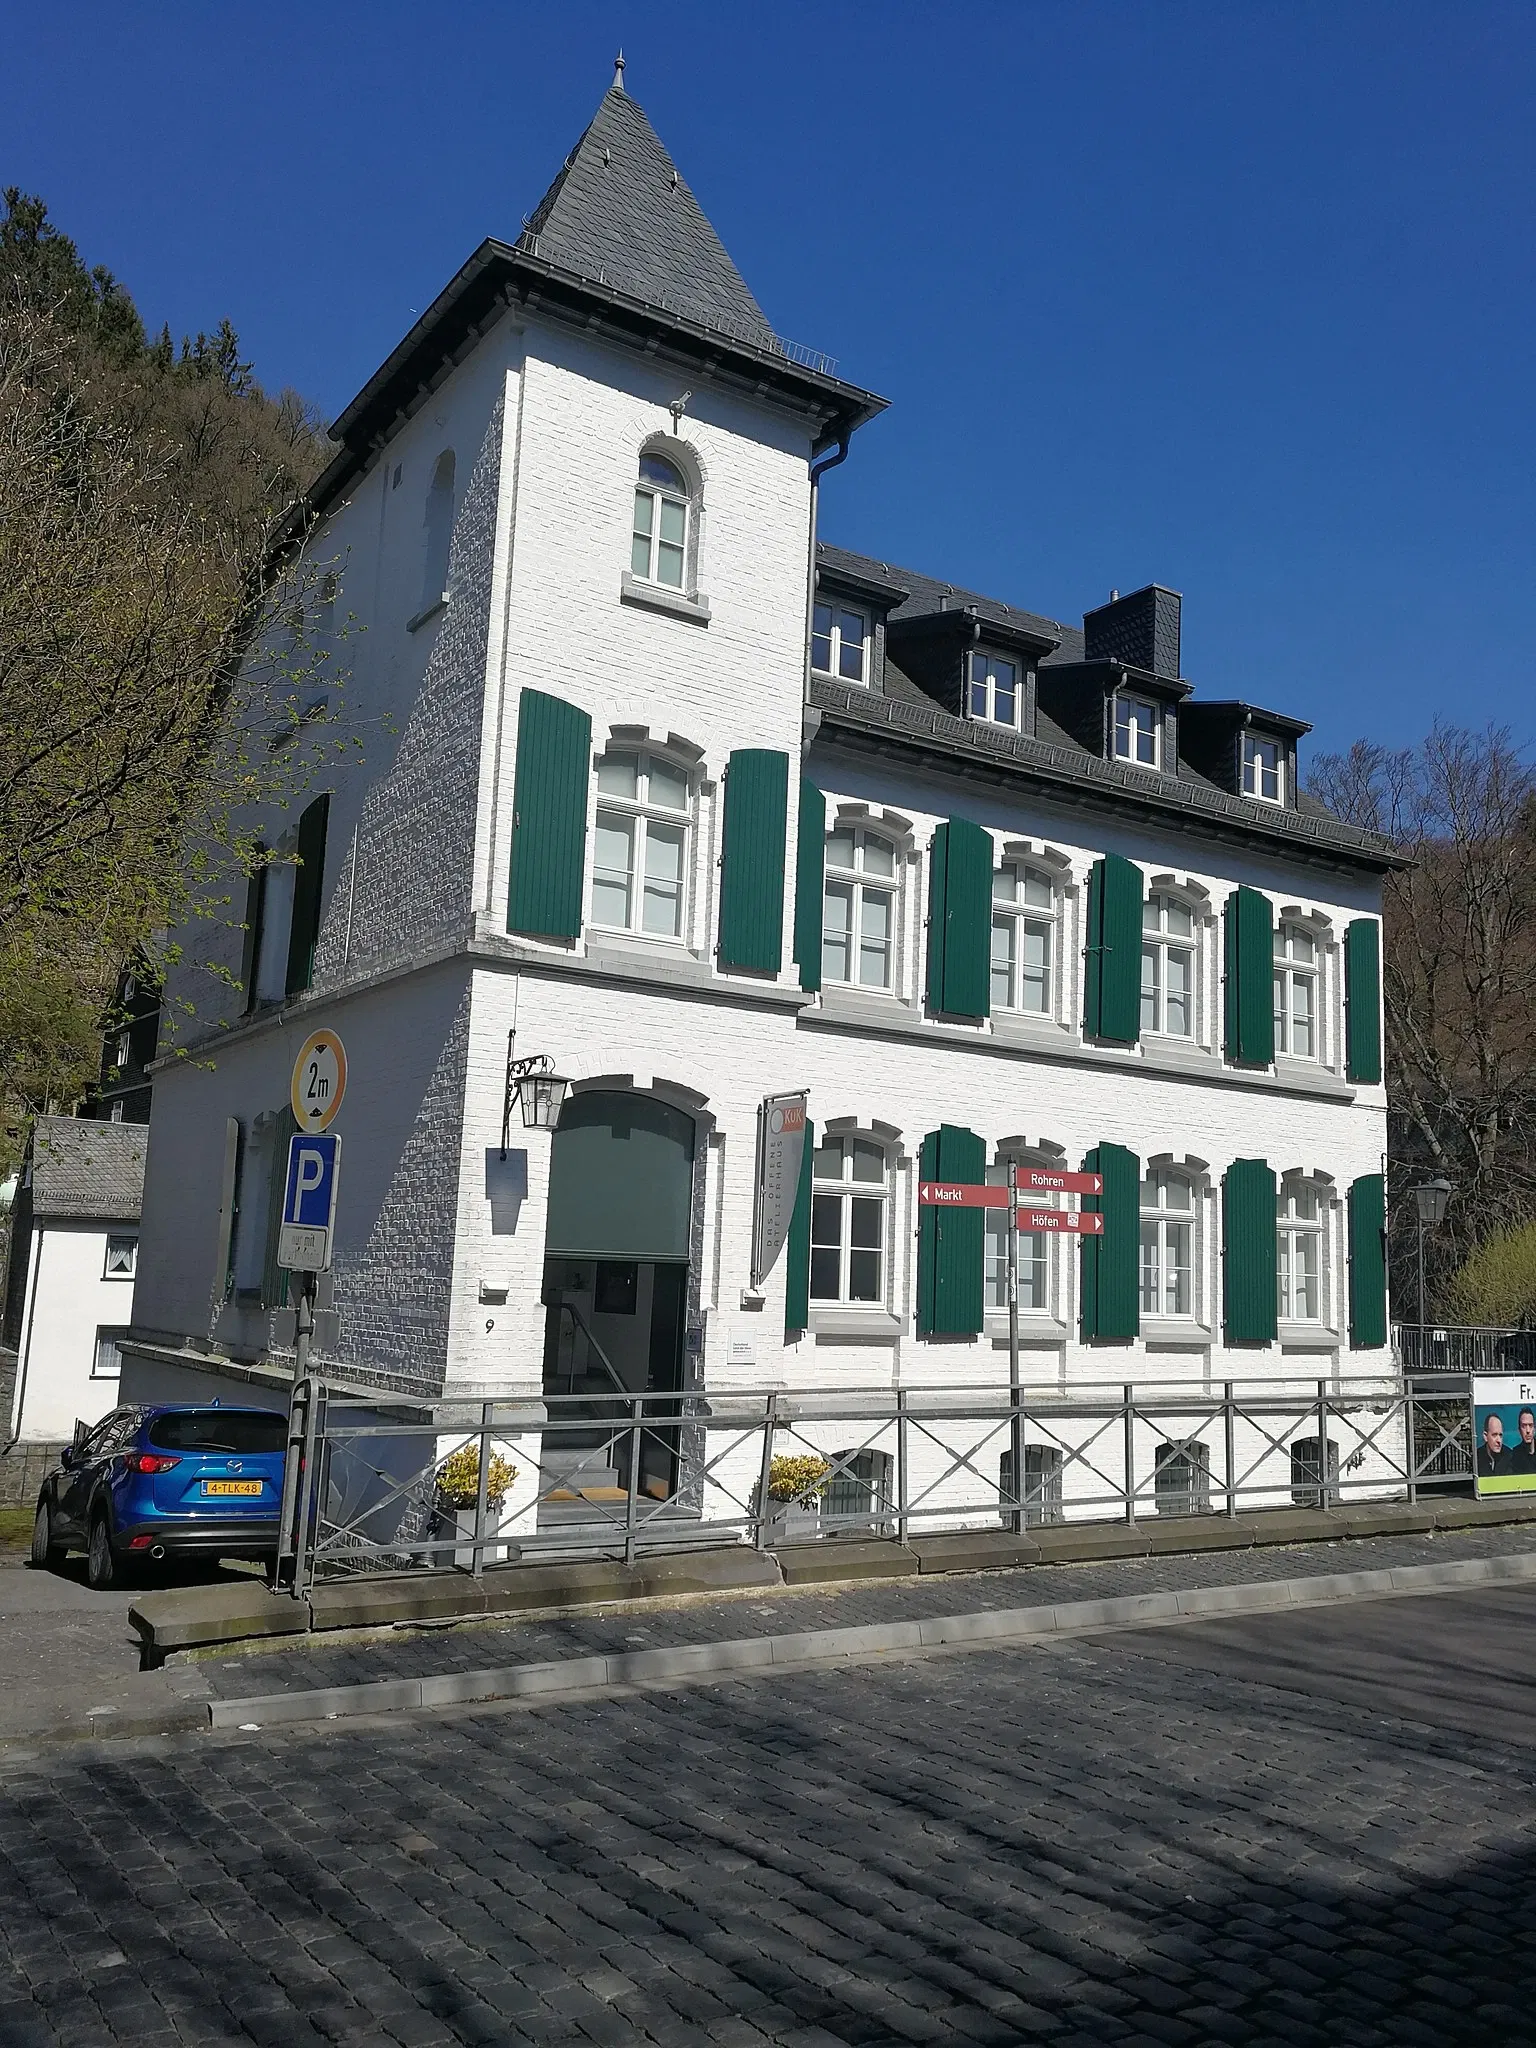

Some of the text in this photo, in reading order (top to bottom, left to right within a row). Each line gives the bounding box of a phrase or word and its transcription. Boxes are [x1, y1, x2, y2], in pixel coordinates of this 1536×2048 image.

[307, 1062, 329, 1098] 2m
[293, 1149, 324, 1221] P
[1031, 1173, 1064, 1187] Rohren
[774, 1140, 782, 1246] ATELIERHAUS
[935, 1187, 962, 1201] Markt
[1031, 1214, 1059, 1227] Höfen
[485, 1318, 495, 1334] 9
[1520, 1384, 1534, 1400] Fr.
[211, 1483, 258, 1493] 4-TLK-48
